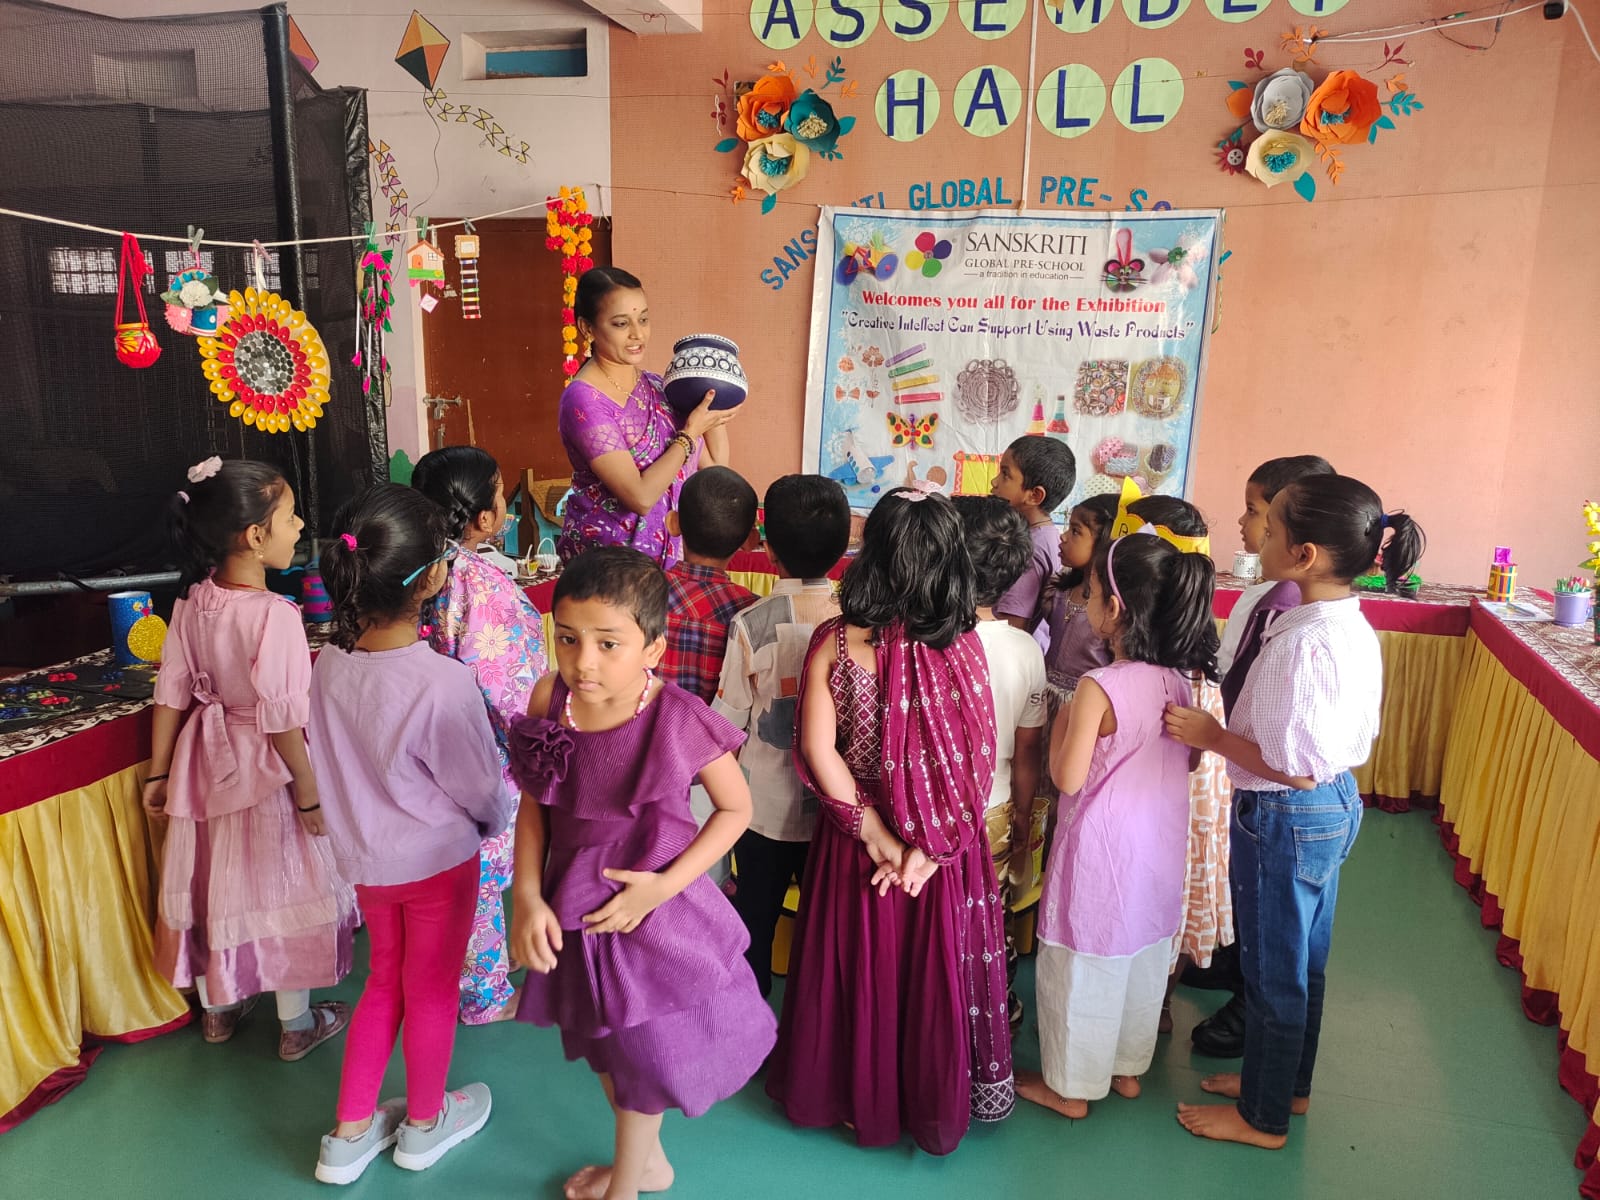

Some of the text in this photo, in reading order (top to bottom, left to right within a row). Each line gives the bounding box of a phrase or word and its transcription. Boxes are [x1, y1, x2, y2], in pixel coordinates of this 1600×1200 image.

[887, 64, 1164, 137] HALL
[909, 177, 1012, 211] GLOBAL
[966, 231, 1088, 255] SANSKRITI
[965, 258, 1086, 272] GLOBAL PRE-SCHOOL
[986, 270, 1018, 279] tradition
[1020, 271, 1028, 279] in
[1029, 271, 1069, 281] education
[862, 290, 1166, 313] Welcomes you all for the Exhibition
[898, 315, 945, 333] Intellect
[947, 316, 974, 334] Can
[977, 317, 1031, 340] Support
[1035, 319, 1073, 342] Using
[1078, 320, 1121, 338] Waste
